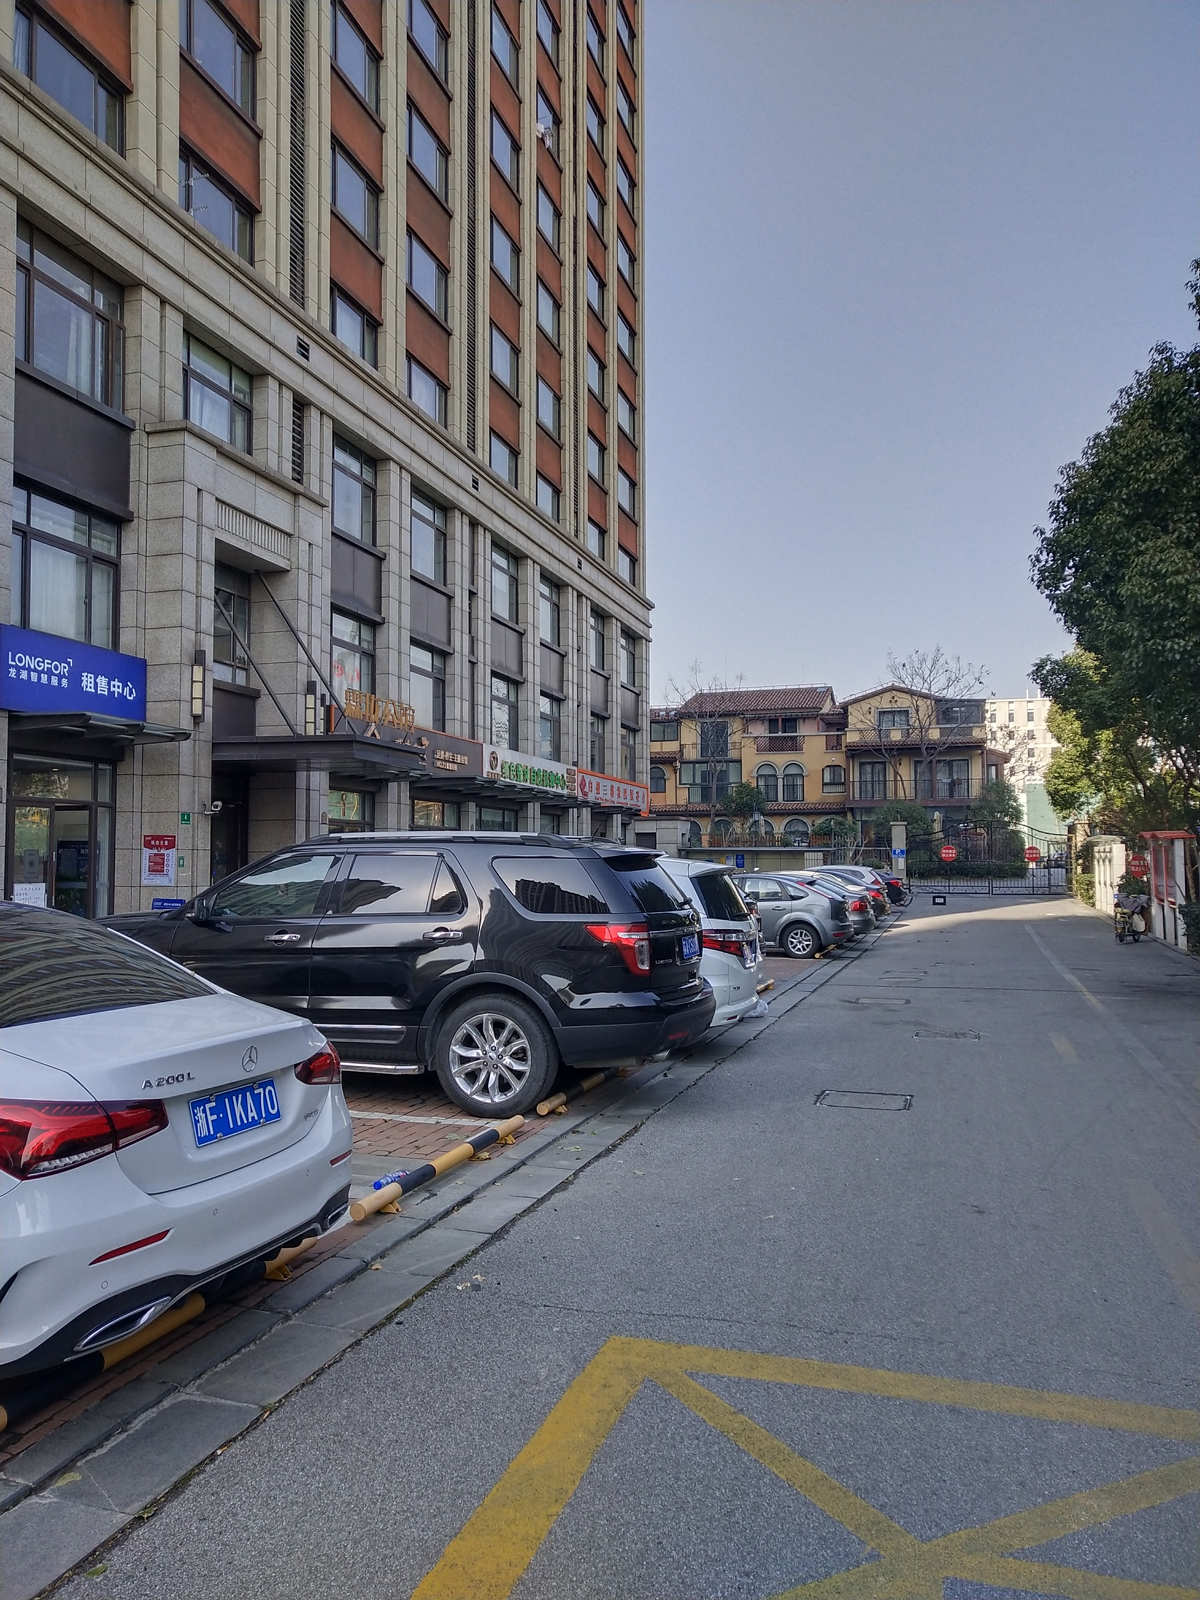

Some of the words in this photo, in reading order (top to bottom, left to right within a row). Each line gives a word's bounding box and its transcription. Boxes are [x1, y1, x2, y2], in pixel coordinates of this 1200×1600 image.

[8, 651, 69, 676] LONGFOR
[8, 667, 69, 688] 龙湖智慧服务
[81, 672, 137, 700] 租售中心
